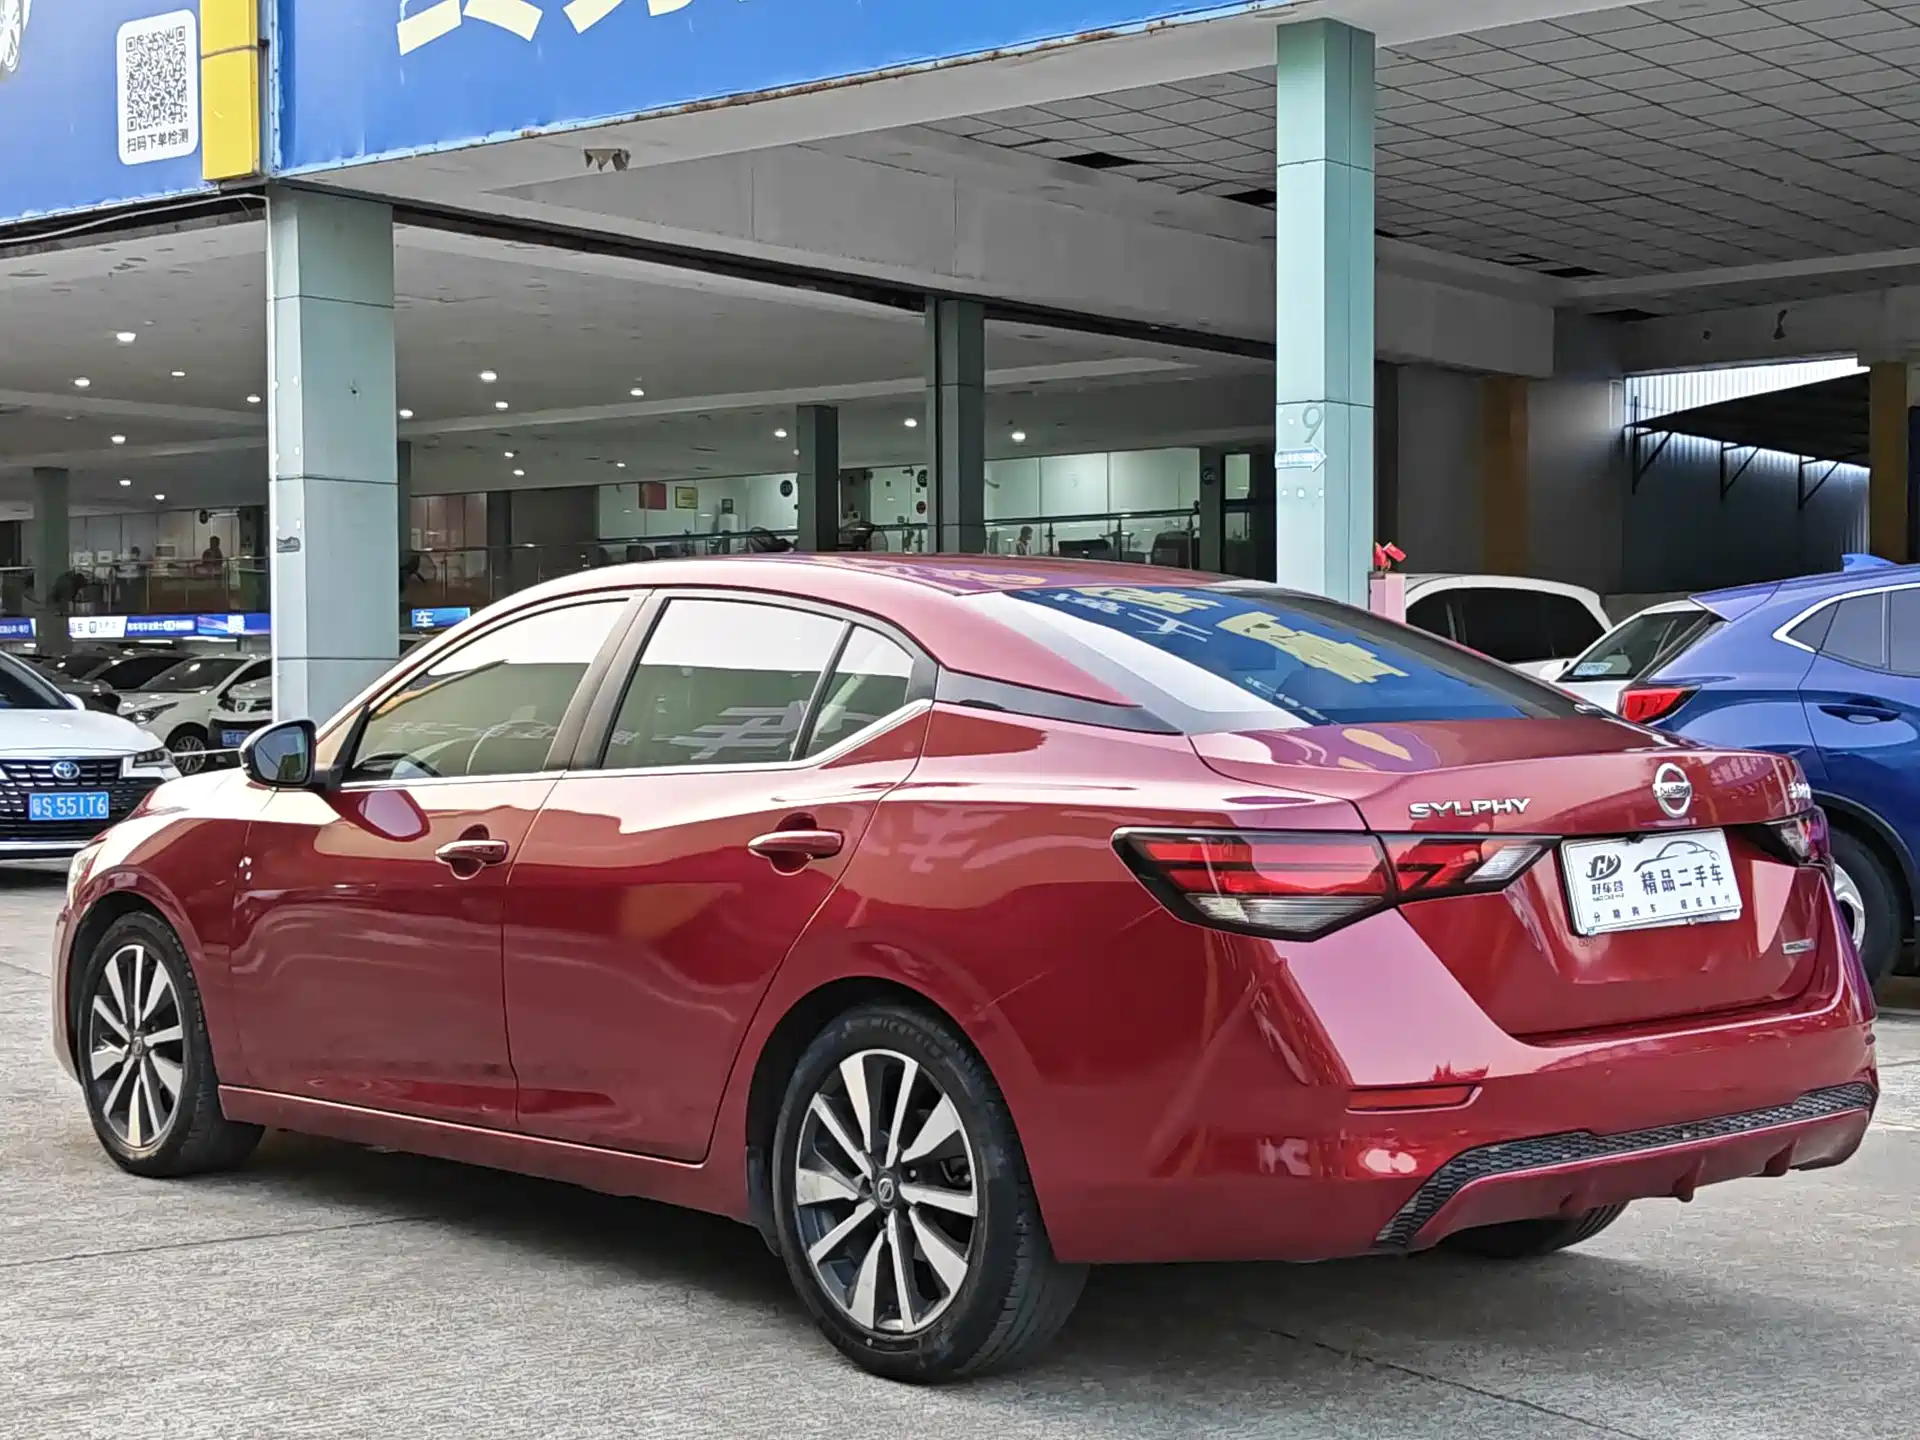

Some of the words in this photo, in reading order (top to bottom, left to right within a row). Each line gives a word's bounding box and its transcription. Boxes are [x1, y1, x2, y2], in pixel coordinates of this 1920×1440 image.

[127, 128, 189, 153] 扫码下单检测
[1301, 404, 1323, 443] 9
[1408, 797, 1531, 820] SYLPHY
[1640, 863, 1725, 896] 精品二手车
